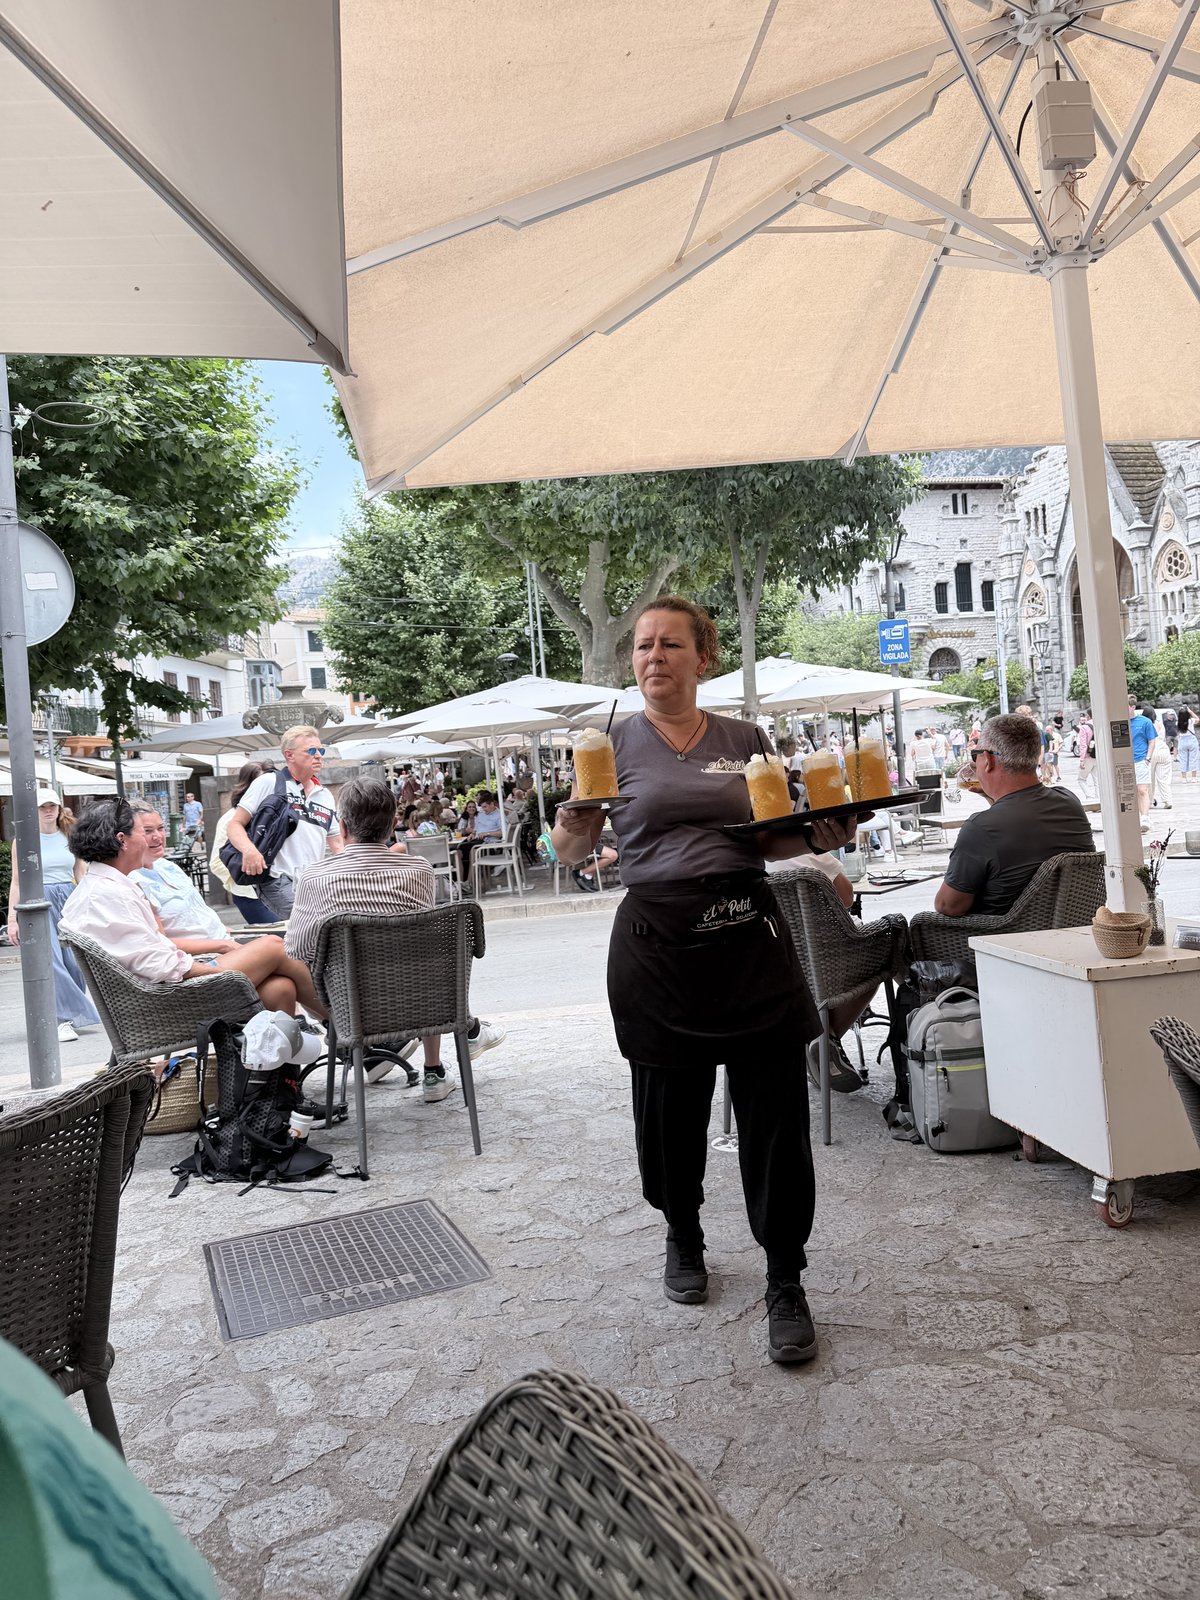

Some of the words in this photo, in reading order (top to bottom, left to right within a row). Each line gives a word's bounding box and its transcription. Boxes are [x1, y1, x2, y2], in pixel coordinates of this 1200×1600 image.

[887, 643, 903, 651] ZONA
[882, 652, 909, 660] VIGILADA
[703, 904, 717, 922] El
[728, 897, 751, 916] Petit
[696, 919, 728, 928] CAFETERIA
